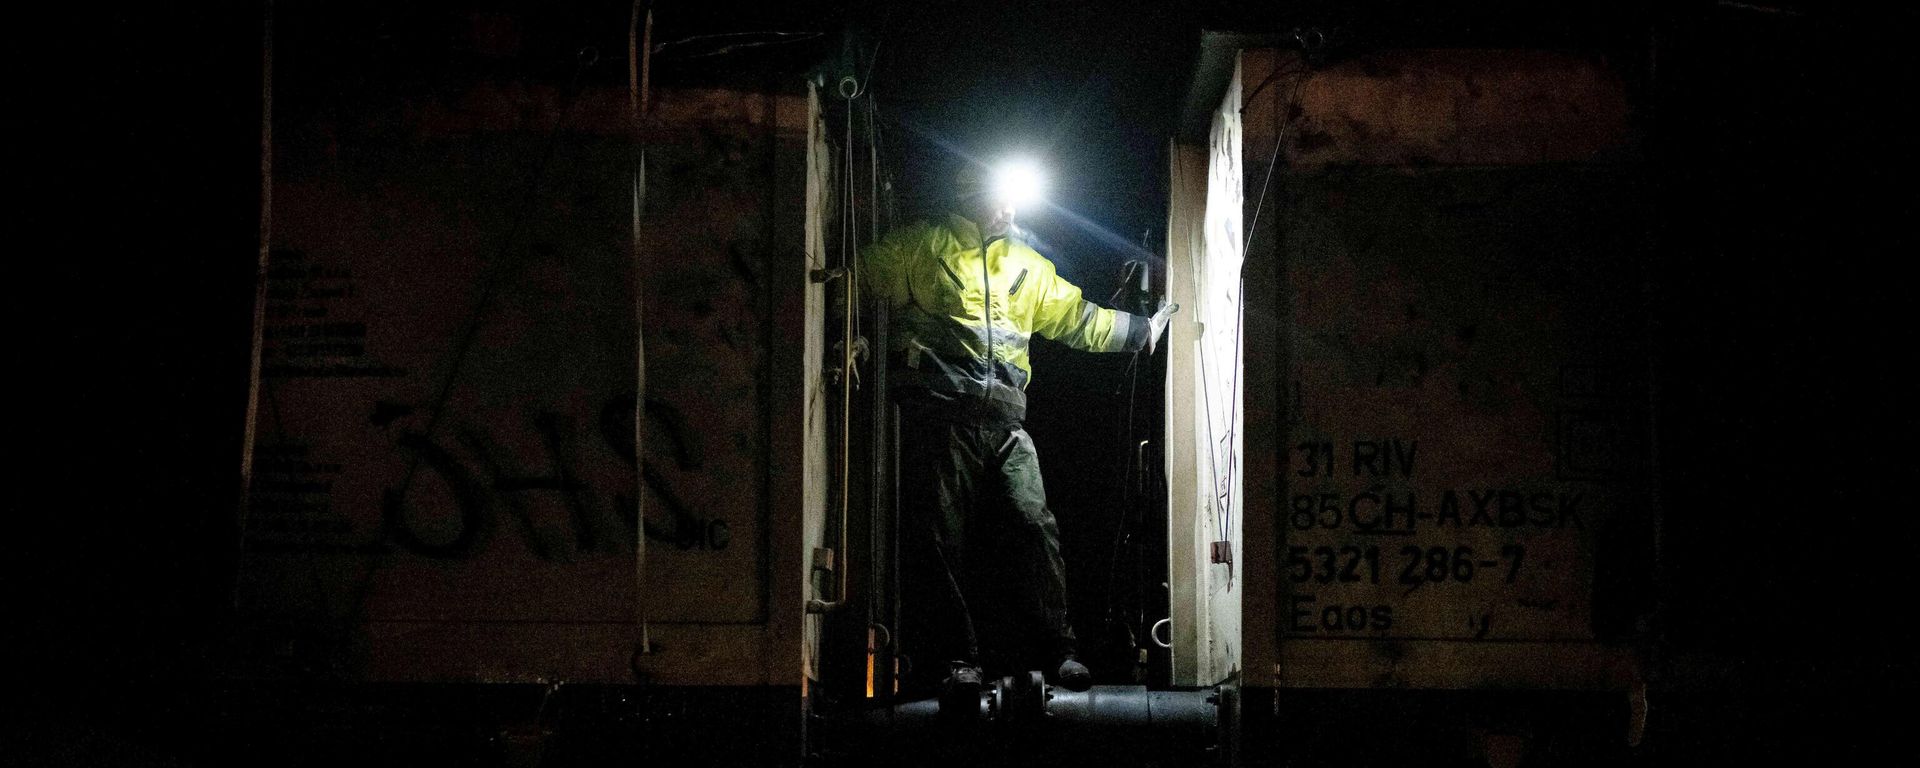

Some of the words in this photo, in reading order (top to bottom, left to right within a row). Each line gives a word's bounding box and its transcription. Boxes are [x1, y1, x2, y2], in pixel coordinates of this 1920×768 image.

[1296, 442, 1334, 478] 31
[1354, 440, 1417, 477] RIV
[1288, 546, 1380, 583] 5321
[1399, 546, 1526, 583] 286-7
[1291, 596, 1393, 632] Eaos
